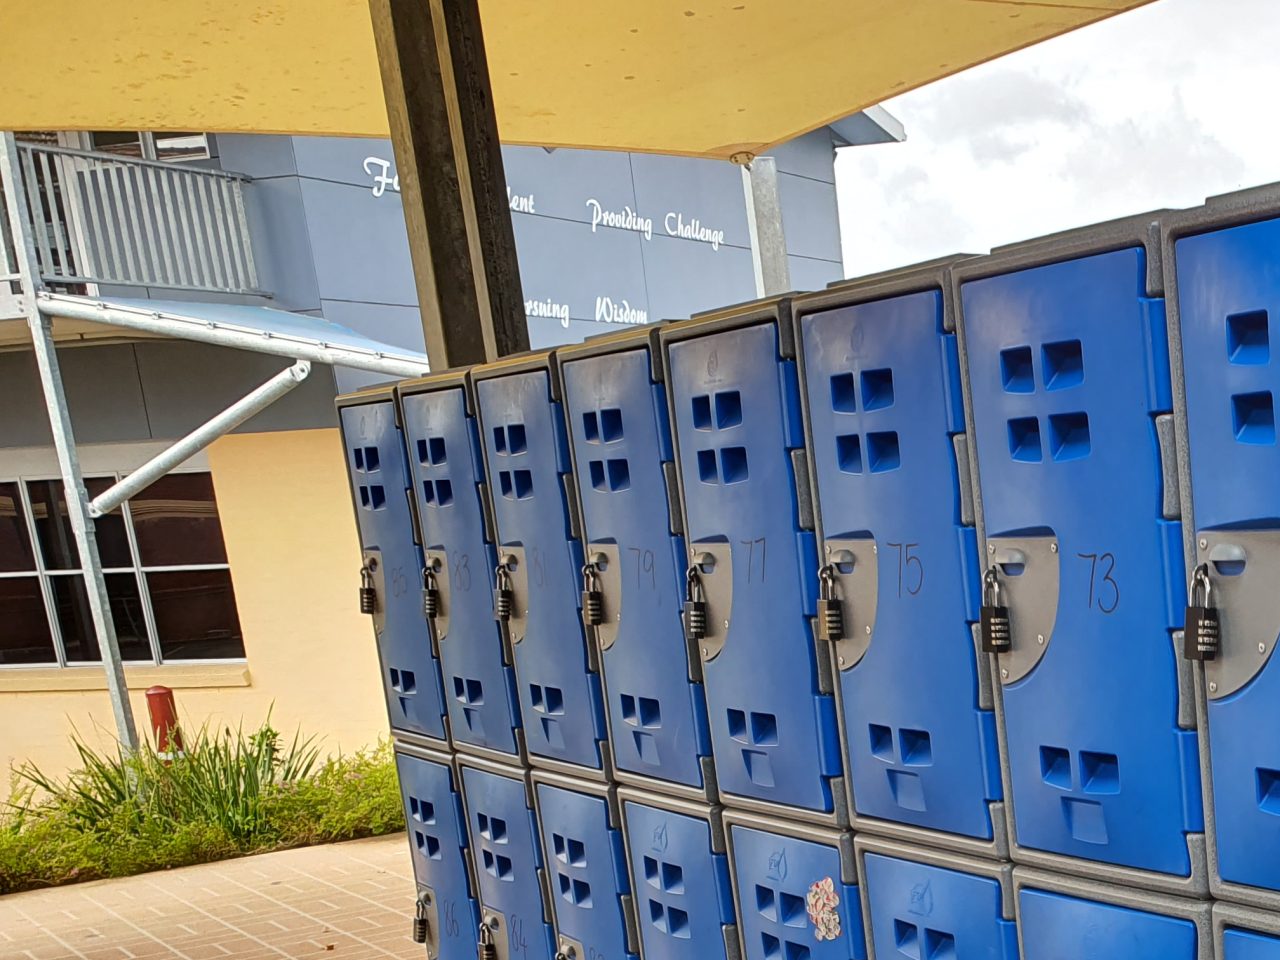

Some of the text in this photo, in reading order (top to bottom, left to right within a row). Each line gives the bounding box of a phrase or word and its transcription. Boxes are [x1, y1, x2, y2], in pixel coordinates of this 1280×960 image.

[586, 199, 724, 251] Providing Challenge
[595, 296, 648, 324] Wisdom
[628, 547, 656, 590] 79
[740, 536, 767, 584] 77
[886, 542, 924, 599] 75
[1077, 552, 1120, 614] 73
[443, 899, 460, 938] 86
[510, 913, 528, 960] 84
